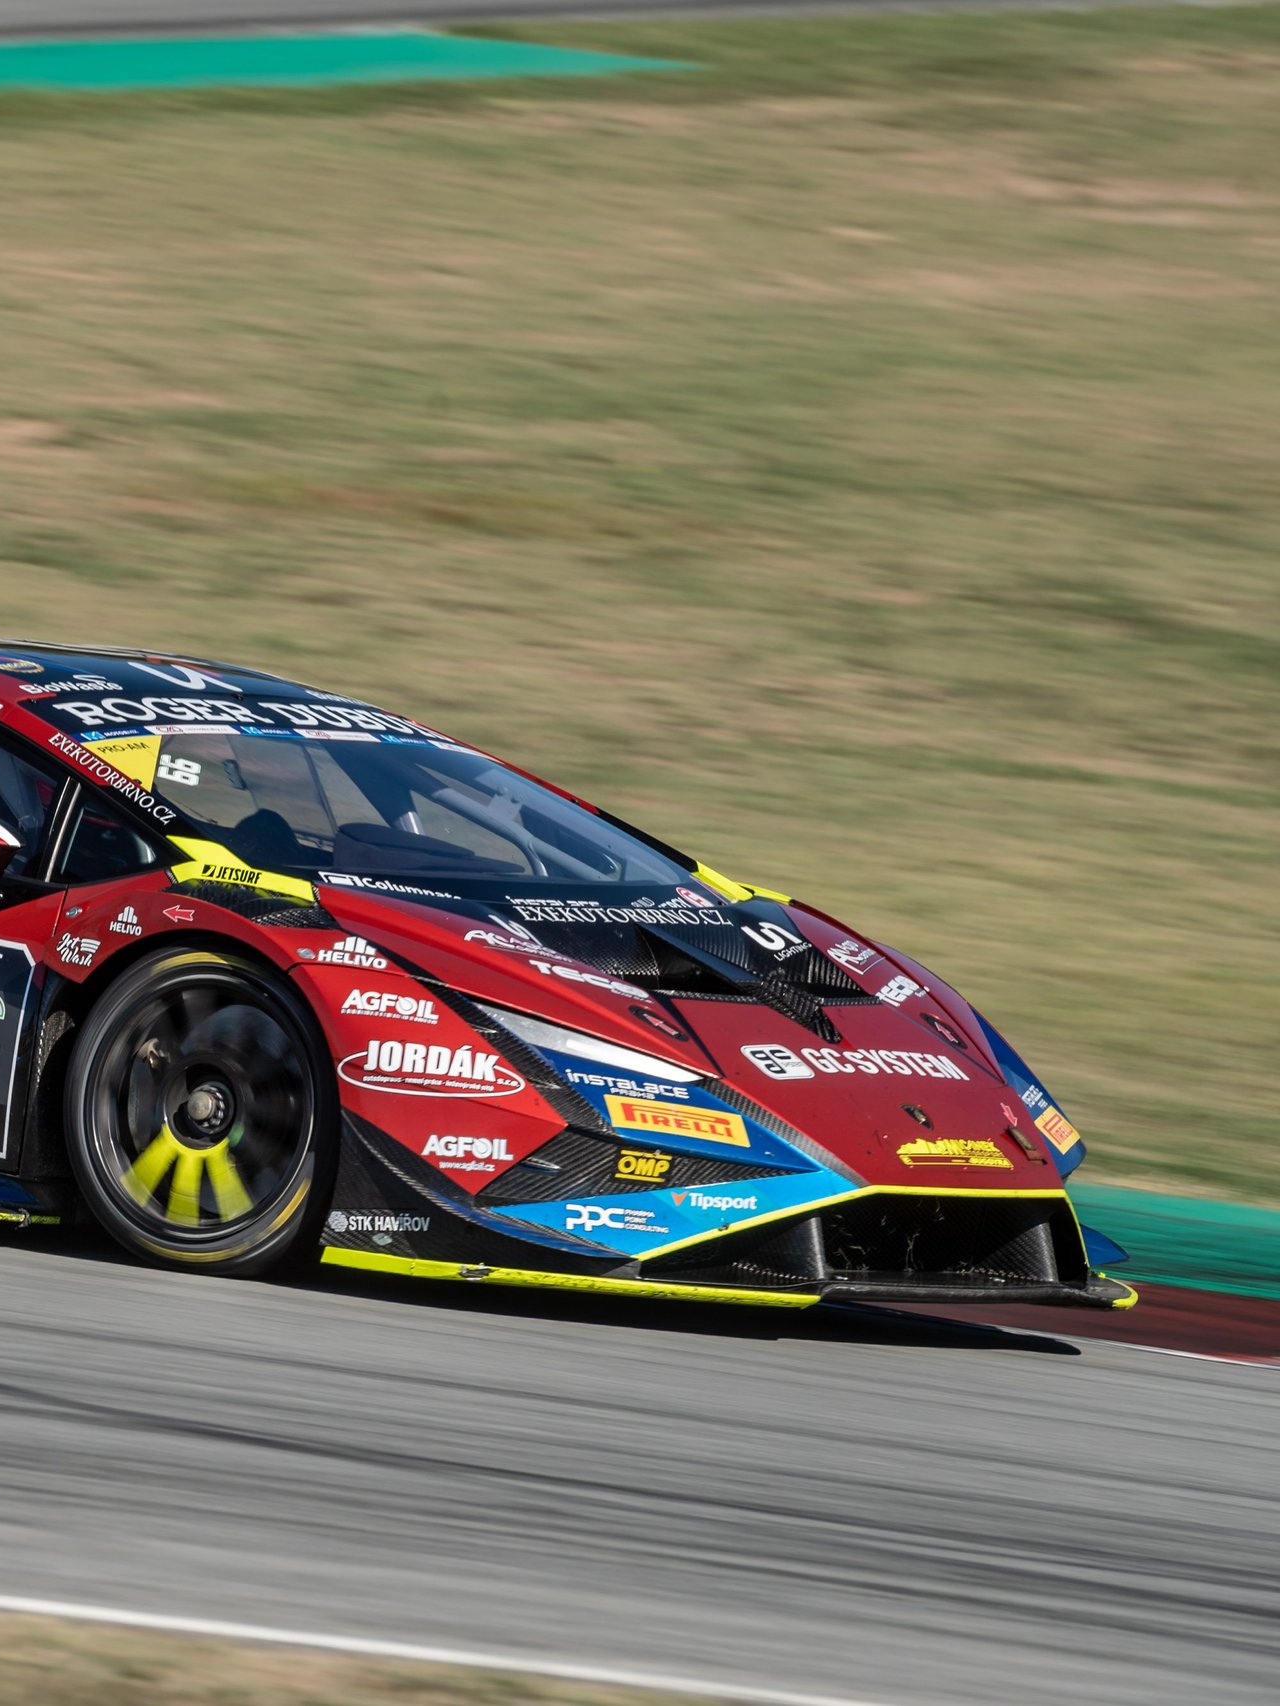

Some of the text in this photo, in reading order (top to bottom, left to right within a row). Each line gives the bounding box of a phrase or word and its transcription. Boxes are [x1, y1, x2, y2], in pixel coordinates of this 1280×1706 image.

[19, 674, 123, 694] BioWaste
[53, 697, 274, 726] ROGER
[97, 742, 150, 754] PRO-AM
[48, 732, 177, 825] EXEKUTORBRNO.CZ
[216, 866, 263, 885] JETSURF
[512, 904, 734, 926] EXEKUTORBRNO.CZ
[109, 921, 143, 936] HELIVO
[317, 949, 388, 969] HELIVO
[341, 988, 440, 1020] AGFOIL
[363, 1040, 500, 1082] JORDÁK
[800, 1048, 971, 1081] GC SYSTEM
[620, 1103, 735, 1139] PIRELLI
[421, 1134, 514, 1160] AGFOIL
[617, 1156, 670, 1177] OMP
[688, 1192, 757, 1211] Tipsport
[348, 1212, 430, 1232] STK HAVÍŘOV
[565, 1204, 625, 1232] PPC
